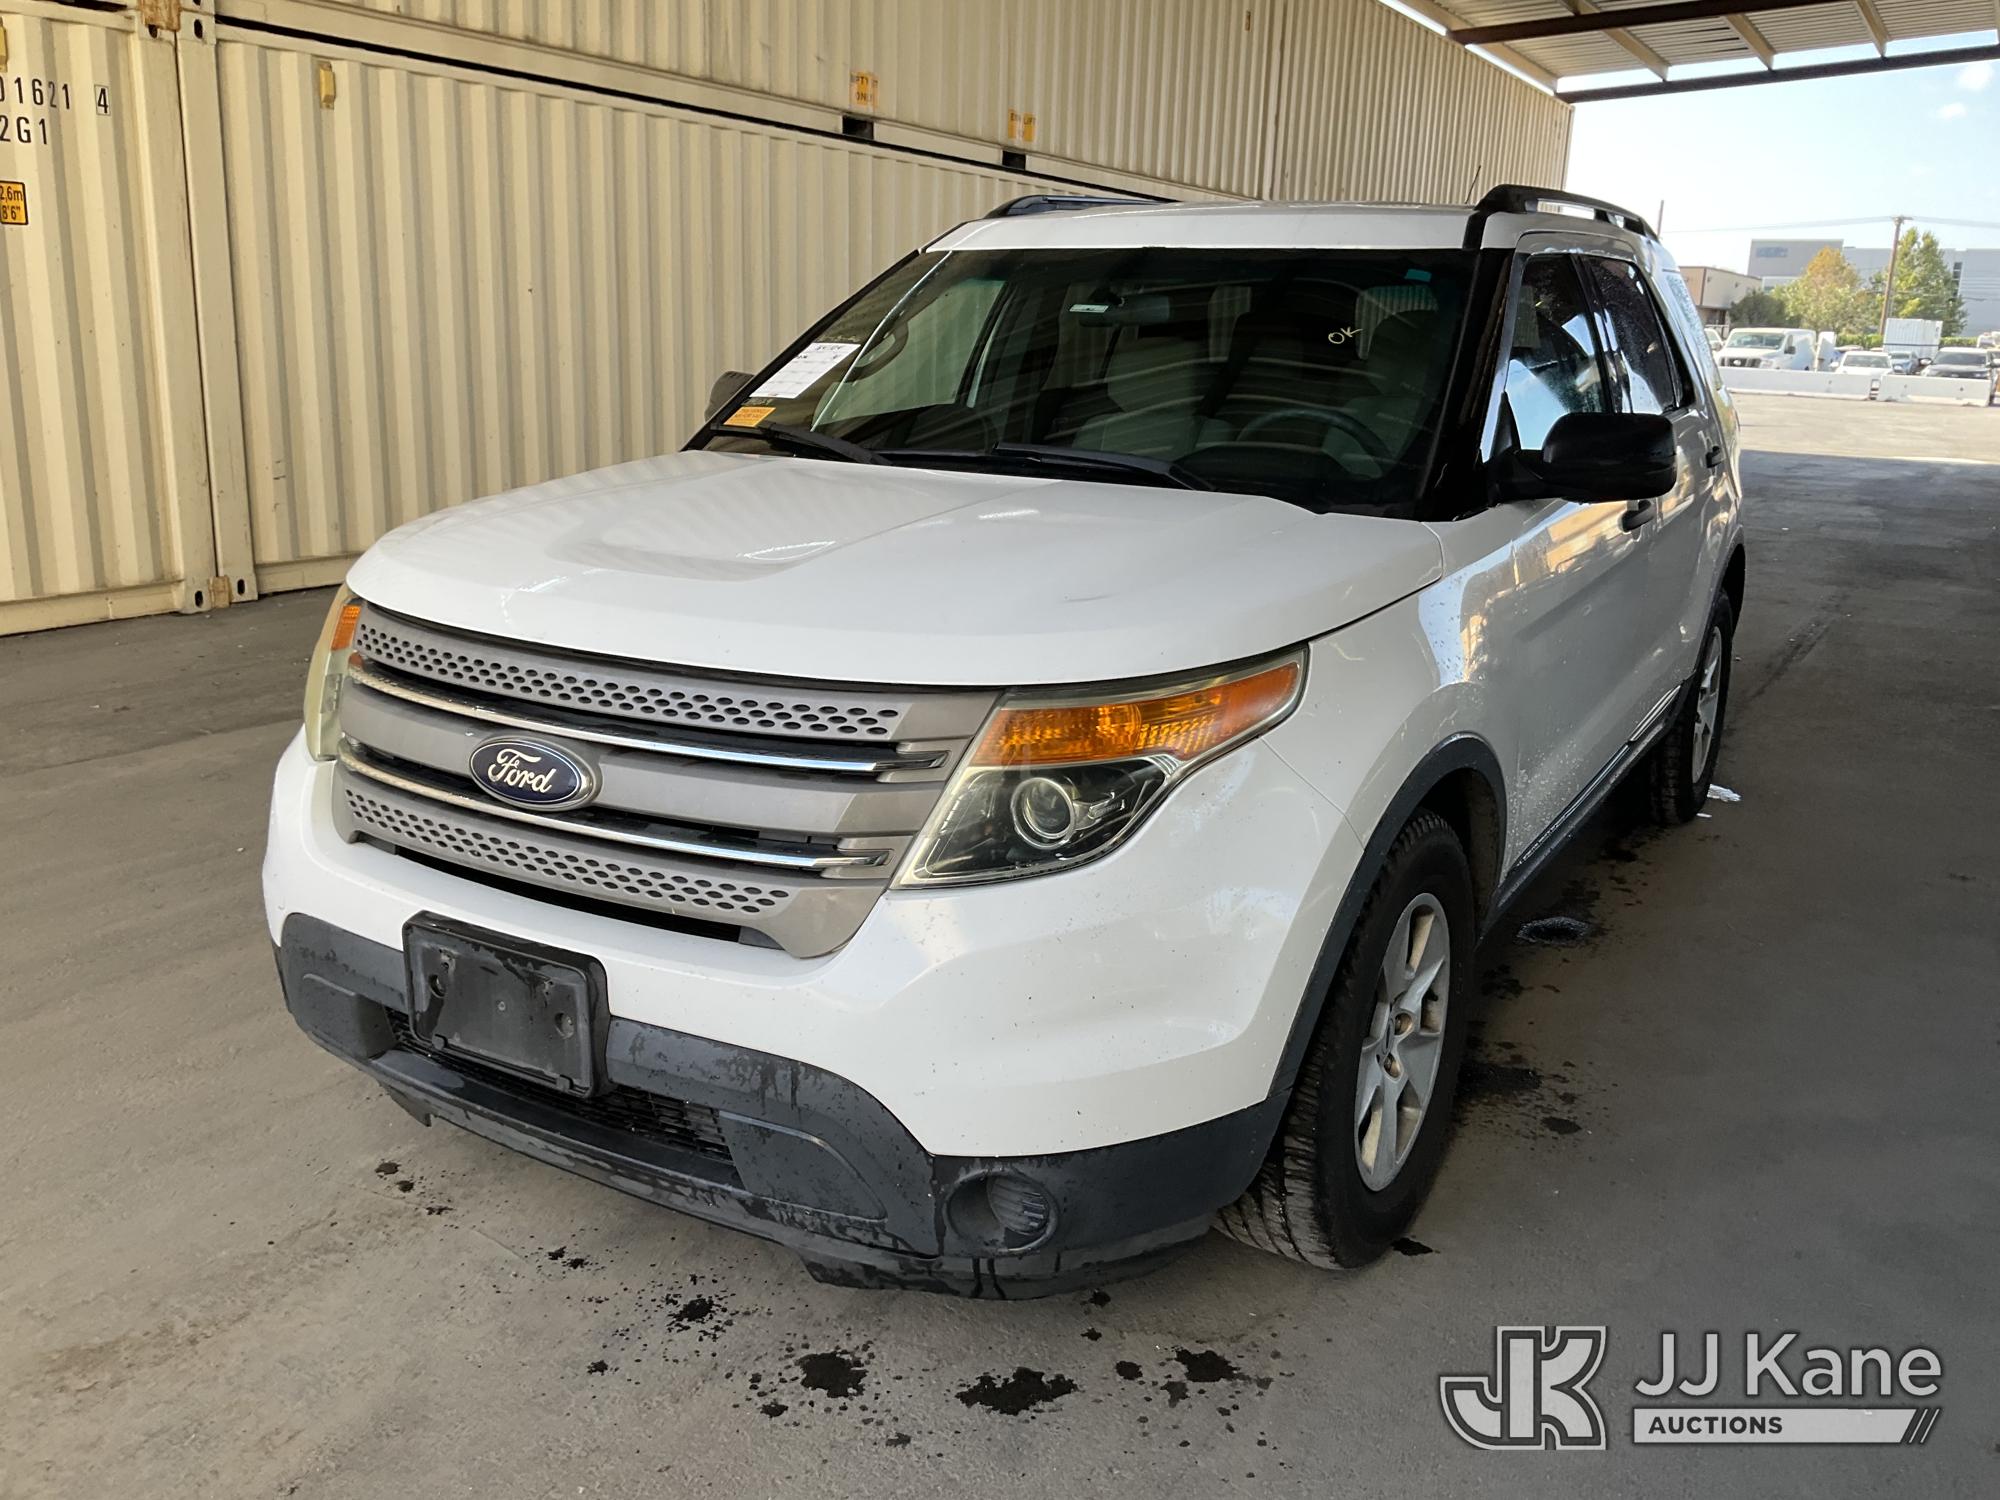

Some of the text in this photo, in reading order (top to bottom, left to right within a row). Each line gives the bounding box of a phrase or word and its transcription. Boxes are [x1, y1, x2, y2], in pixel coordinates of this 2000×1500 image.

[0, 114, 48, 145] 2G1
[1328, 326, 1363, 344] OK
[487, 748, 557, 793] Ford
